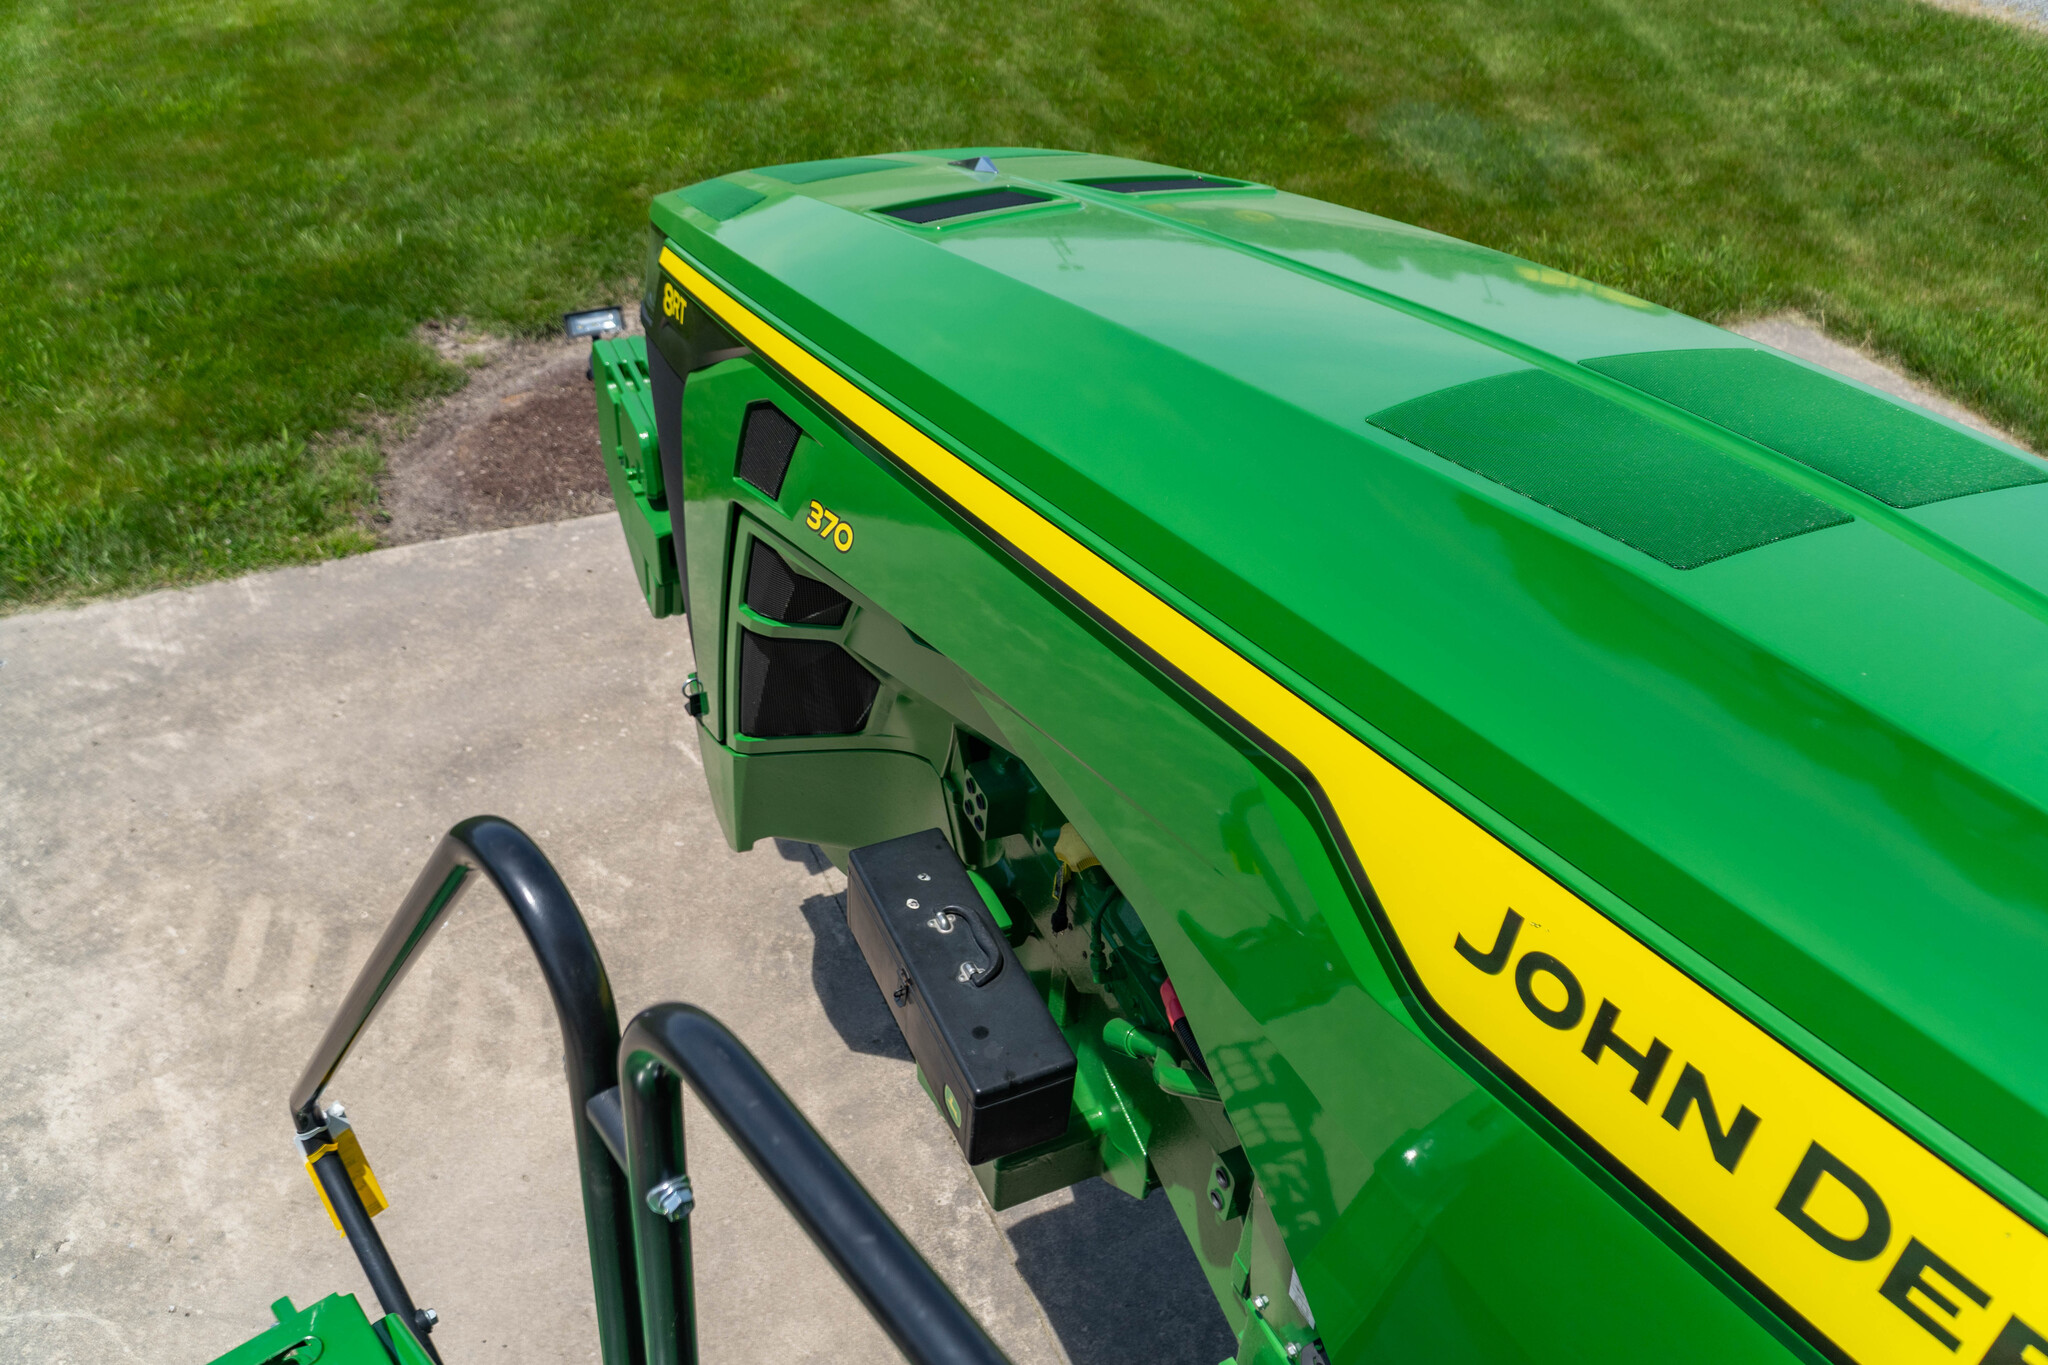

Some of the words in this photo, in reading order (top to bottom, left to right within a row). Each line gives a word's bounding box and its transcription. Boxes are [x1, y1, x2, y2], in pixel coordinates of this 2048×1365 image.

[662, 282, 688, 325] 8RT
[805, 498, 855, 554] 370
[1453, 906, 1762, 1175] JOHN
